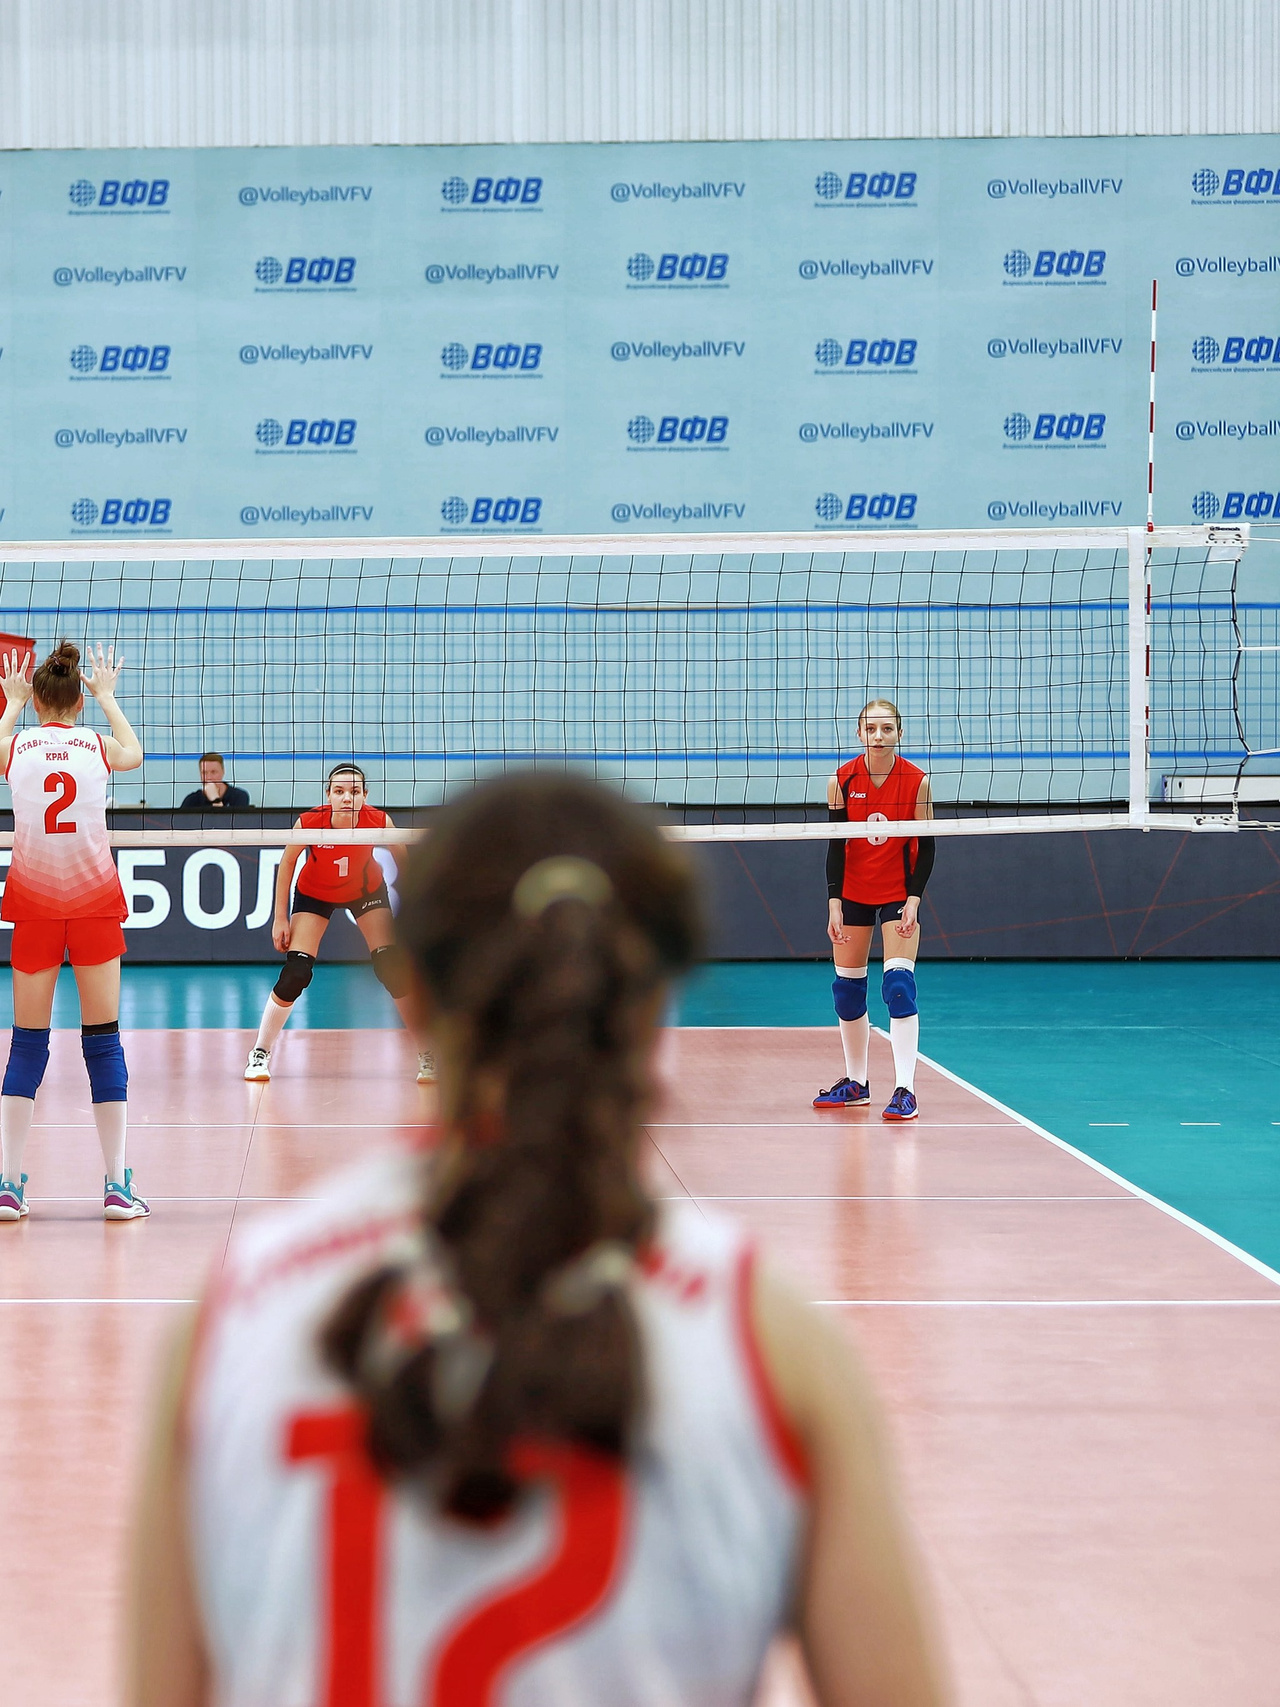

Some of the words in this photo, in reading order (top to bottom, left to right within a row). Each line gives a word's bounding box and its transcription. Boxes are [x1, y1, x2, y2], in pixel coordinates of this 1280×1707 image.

[99, 179, 170, 206] ВФВ
[238, 185, 373, 207] @VolleyballVFV
[472, 177, 543, 204] ВФВ
[610, 181, 746, 203] @VolleyballVFV
[845, 172, 918, 199] ВФВ
[986, 177, 1124, 199] @VolleyballVFV
[285, 257, 357, 284] ВФВ
[424, 263, 560, 285] @VolleyballVFV
[657, 253, 730, 281] ВФВ
[798, 258, 934, 281] @VolleyballVFV
[1034, 250, 1107, 277] ВФВ
[52, 266, 187, 287] @VolleyballVFV
[100, 345, 172, 372] ВФВ
[238, 343, 374, 365] @VolleyballVFV
[471, 343, 544, 370] ВФВ
[610, 340, 746, 362] @VolleyballVFV
[845, 339, 918, 366] ВФВ
[987, 337, 1123, 359] @VolleyballVFV
[54, 427, 188, 449] @VolleyballVFV
[286, 419, 358, 446] ВФВ
[424, 425, 560, 447] @VolleyballVFV
[657, 416, 730, 443] ВФВ
[798, 421, 935, 443] @VolleyballVFV
[1033, 413, 1107, 440] ВФВ
[101, 498, 173, 526] ВФВ
[239, 505, 374, 527] @VolleyballVFV
[471, 497, 543, 524] ВФВ
[610, 502, 746, 525] @VolleyballVFV
[845, 493, 919, 521] ВФВ
[986, 499, 1123, 522] @VolleyballVFV
[45, 751, 69, 761] КРАЙ
[43, 771, 77, 834] 2
[333, 856, 349, 877] 1
[281, 1403, 628, 1707] 12
